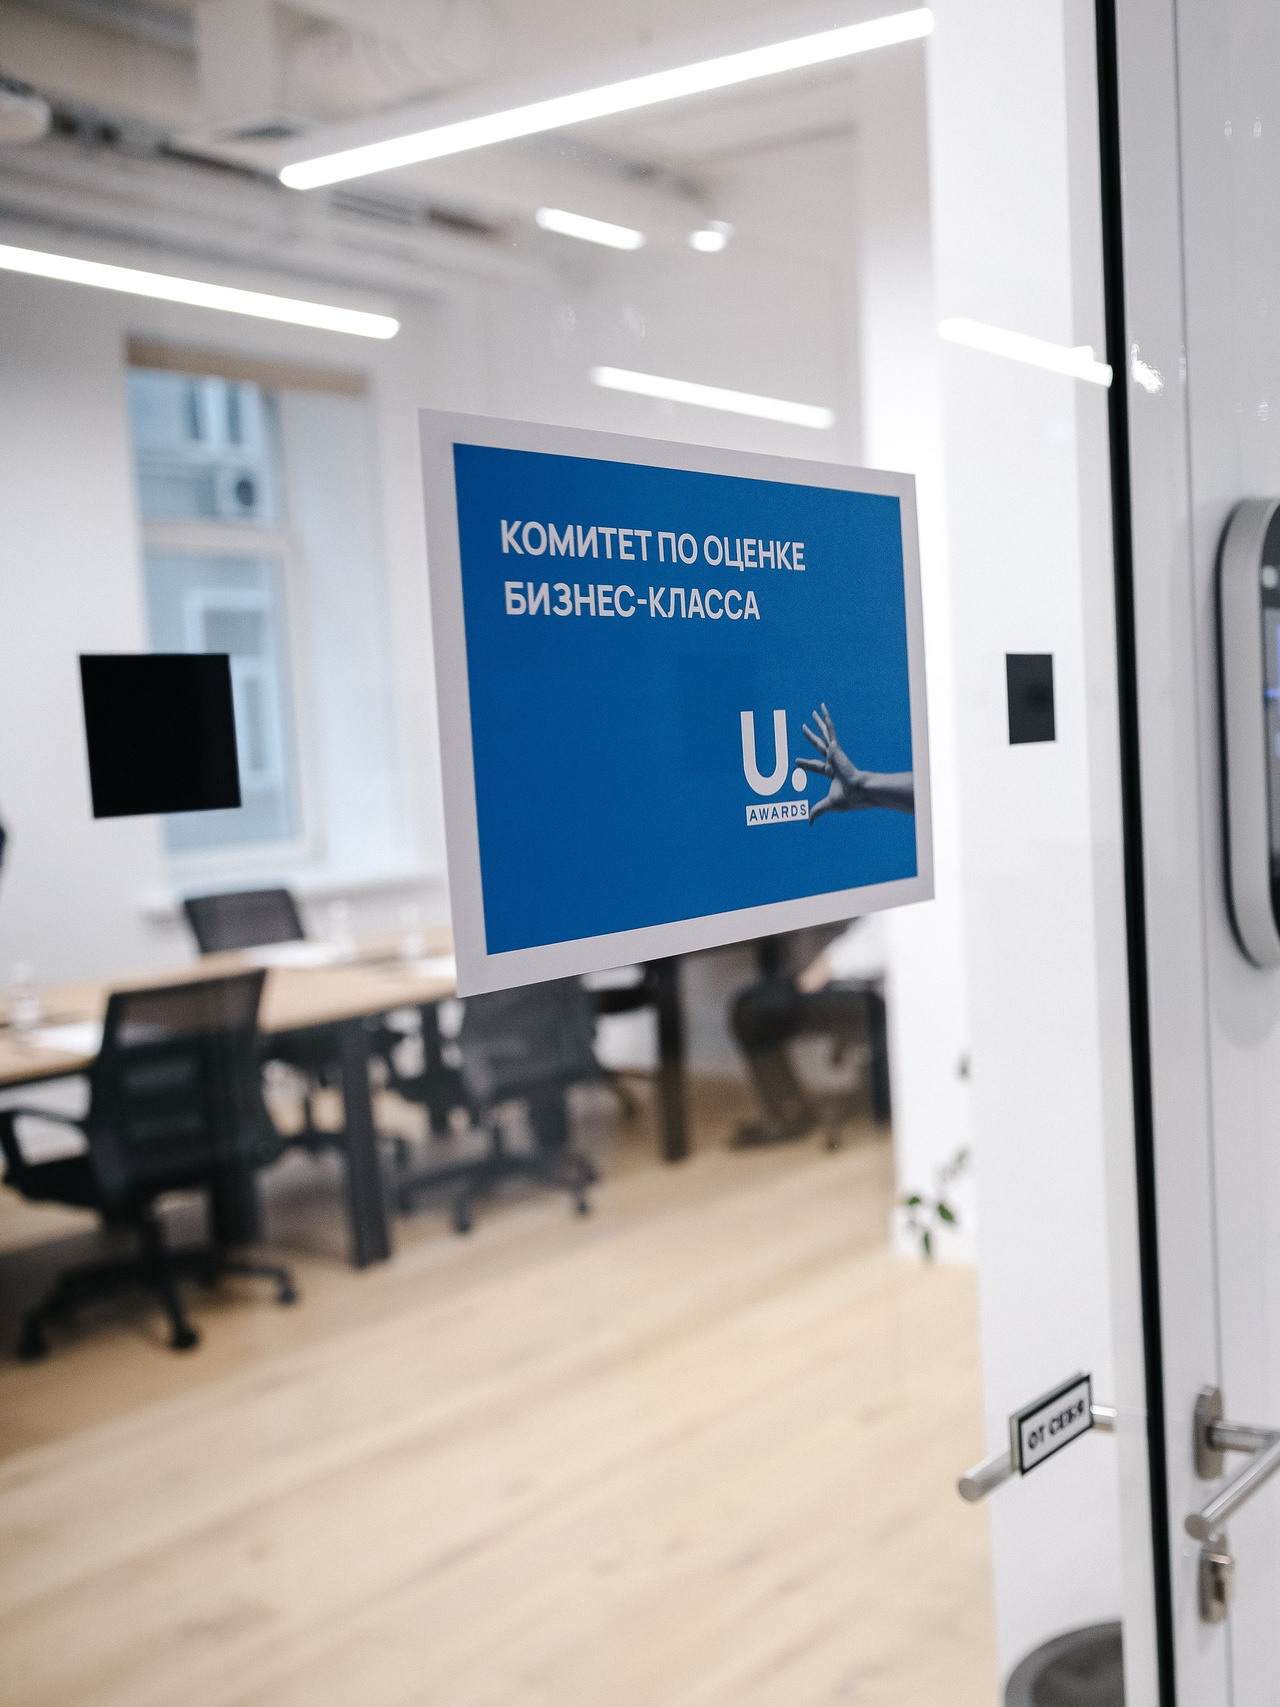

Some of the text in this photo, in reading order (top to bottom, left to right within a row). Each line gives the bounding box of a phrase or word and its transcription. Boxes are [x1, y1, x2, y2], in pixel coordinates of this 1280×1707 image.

[500, 519, 806, 571] КОМИТЕТ ПО ОЦЕНКЕ
[504, 581, 761, 620] БИЗНЕС-КЛАССА
[748, 803, 807, 822] AWARDS
